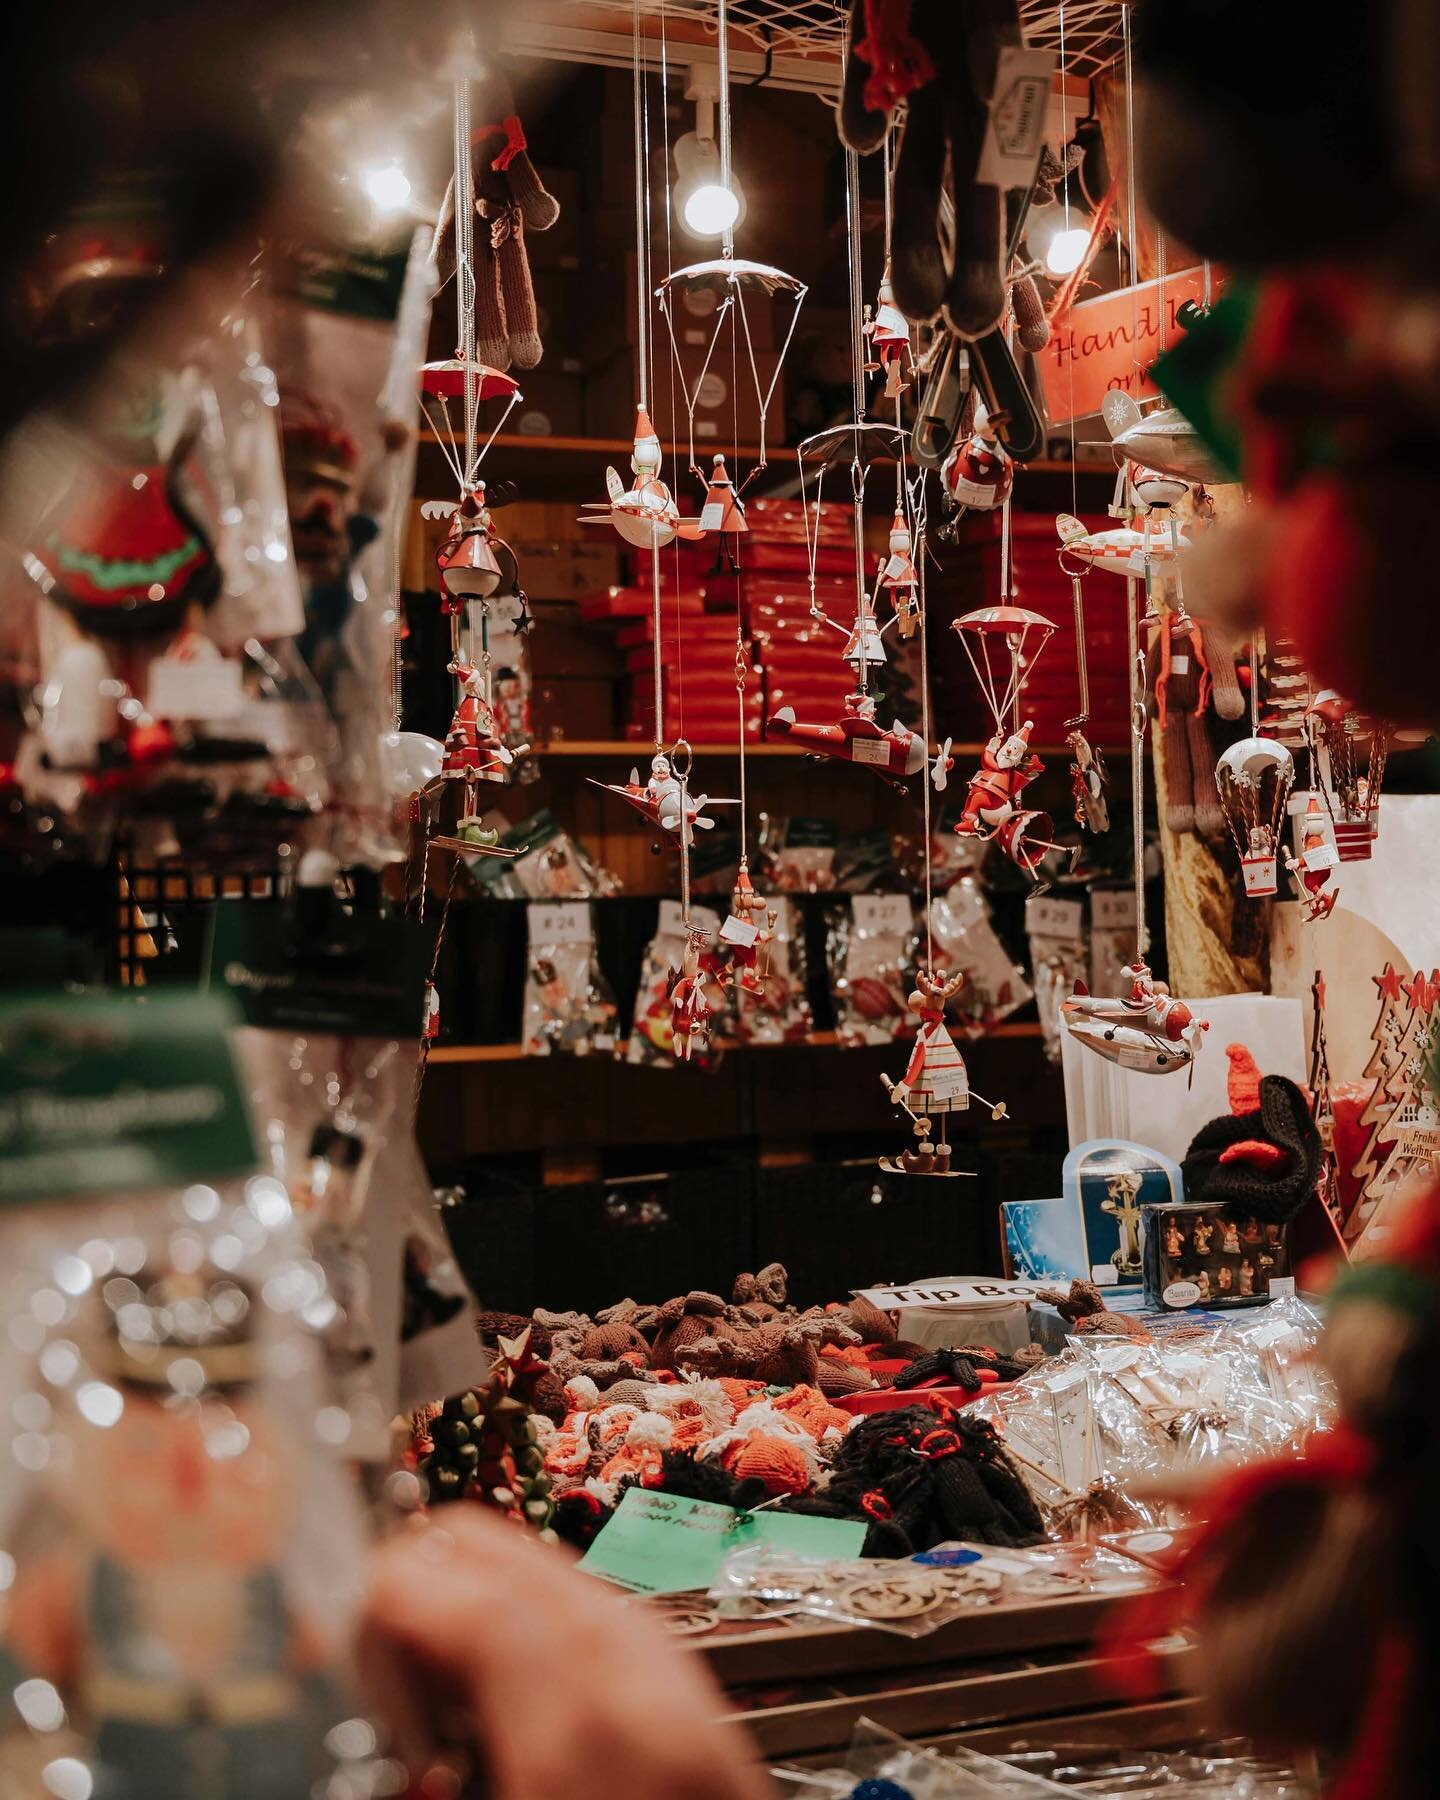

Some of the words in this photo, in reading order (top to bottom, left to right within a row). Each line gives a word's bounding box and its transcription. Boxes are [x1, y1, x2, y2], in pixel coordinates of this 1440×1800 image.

[1053, 306, 1159, 367] Hand
[558, 917, 575, 929] 24
[1412, 1130, 1438, 1144] Frohe
[882, 1289, 961, 1302] Tip
